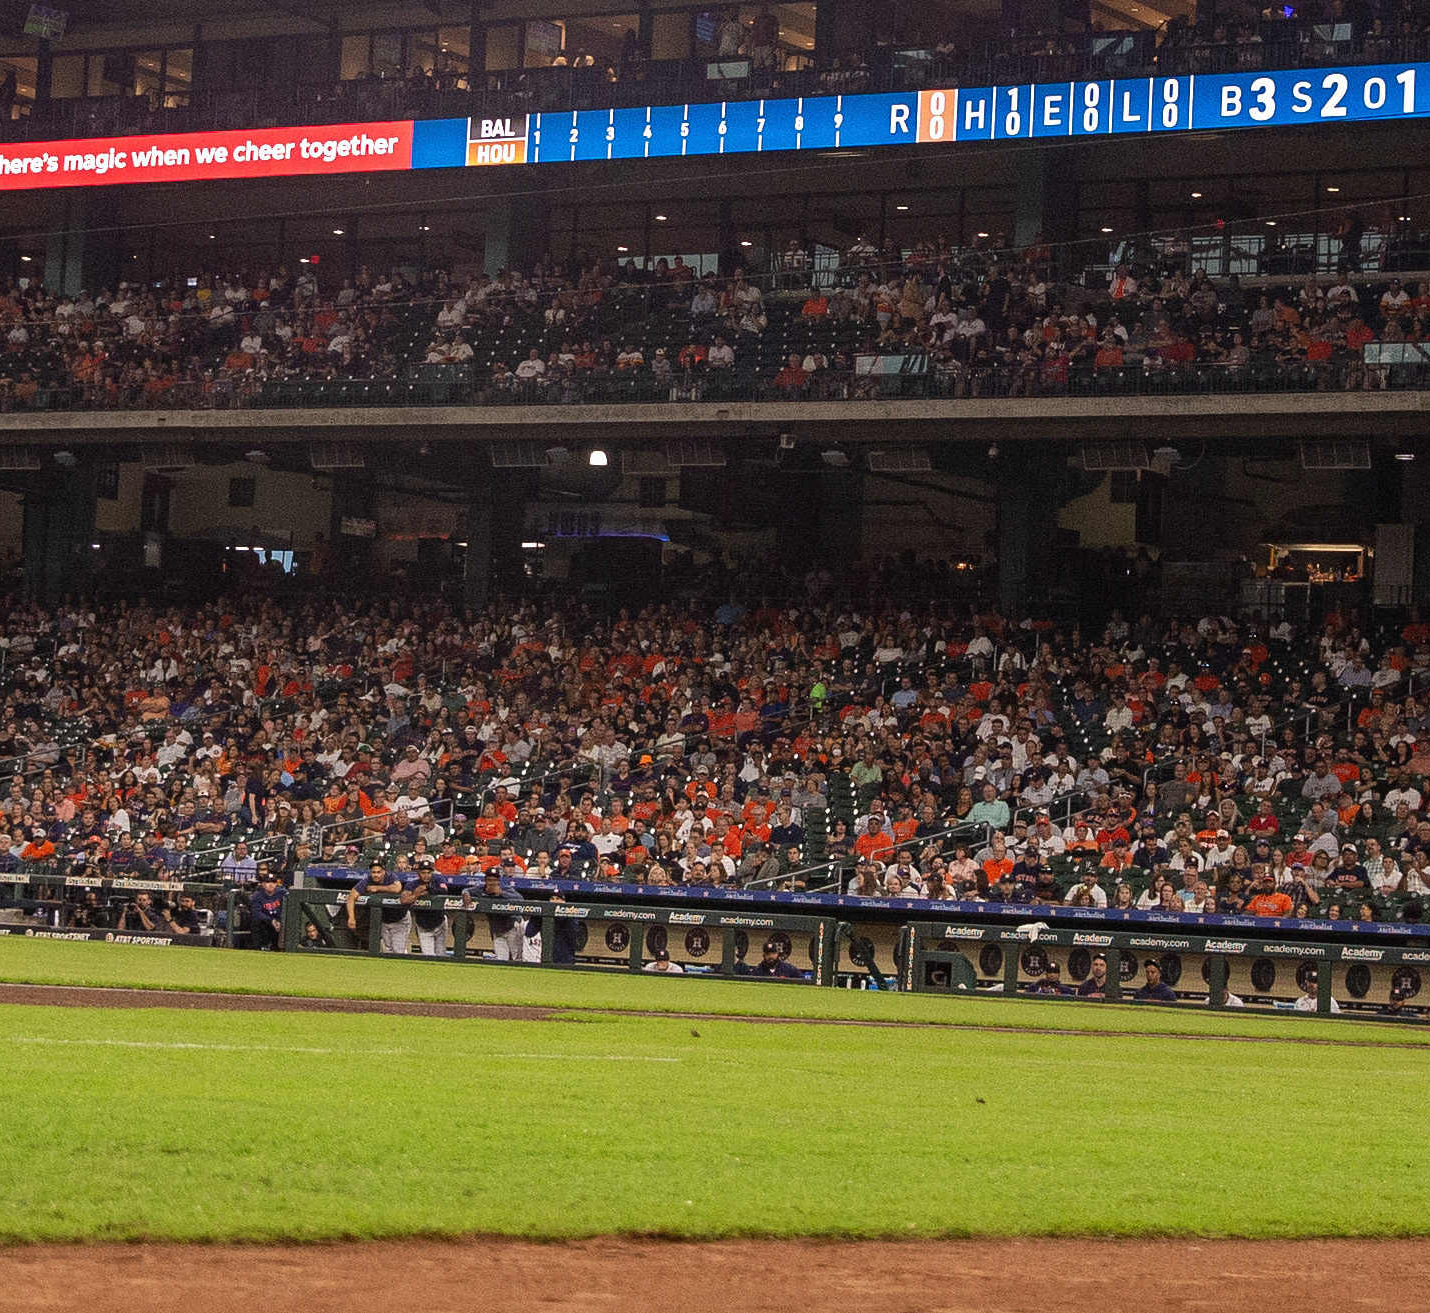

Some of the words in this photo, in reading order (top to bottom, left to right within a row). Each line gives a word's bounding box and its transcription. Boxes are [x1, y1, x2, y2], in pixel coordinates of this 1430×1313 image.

[930, 92, 944, 115] 0
[1008, 88, 1018, 112] 1
[1085, 83, 1099, 107] 0
[1164, 79, 1179, 103] 0
[1220, 85, 1242, 117] B
[1248, 77, 1276, 121] 3
[1291, 81, 1313, 113] S
[1320, 73, 1348, 118] 2
[1363, 77, 1386, 109] O
[1396, 69, 1416, 114] 1
[889, 104, 910, 134] R
[964, 99, 986, 130] H
[1043, 95, 1063, 126] E
[1122, 91, 1141, 122] L
[480, 118, 516, 138] BAL
[929, 115, 944, 140] 0
[1006, 111, 1021, 136] 0
[1083, 107, 1098, 131] 0
[1163, 103, 1178, 127] 0
[533, 130, 541, 145] 1
[569, 128, 579, 143] 2
[605, 126, 615, 141] 3
[642, 124, 653, 139] 4
[680, 122, 690, 137] 5
[718, 120, 728, 135] 6
[756, 118, 766, 133] 7
[794, 115, 804, 131] 8
[833, 113, 844, 129] 9
[63, 147, 128, 174] magic
[131, 145, 191, 168] when
[194, 146, 229, 164] we
[232, 140, 296, 163] cheer
[299, 133, 399, 163] together
[477, 143, 516, 164] HOU
[491, 903, 542, 914] academy.com
[554, 906, 590, 917] Academy
[603, 909, 656, 920] academy.com
[669, 912, 706, 924] Academy
[720, 916, 774, 927] academy.com
[945, 926, 985, 938] Academy
[1073, 933, 1114, 946] Academy
[1130, 937, 1190, 949] academy.com
[1205, 940, 1248, 953] Academy
[1263, 944, 1326, 956] academy.com
[1341, 947, 1385, 960] Academy
